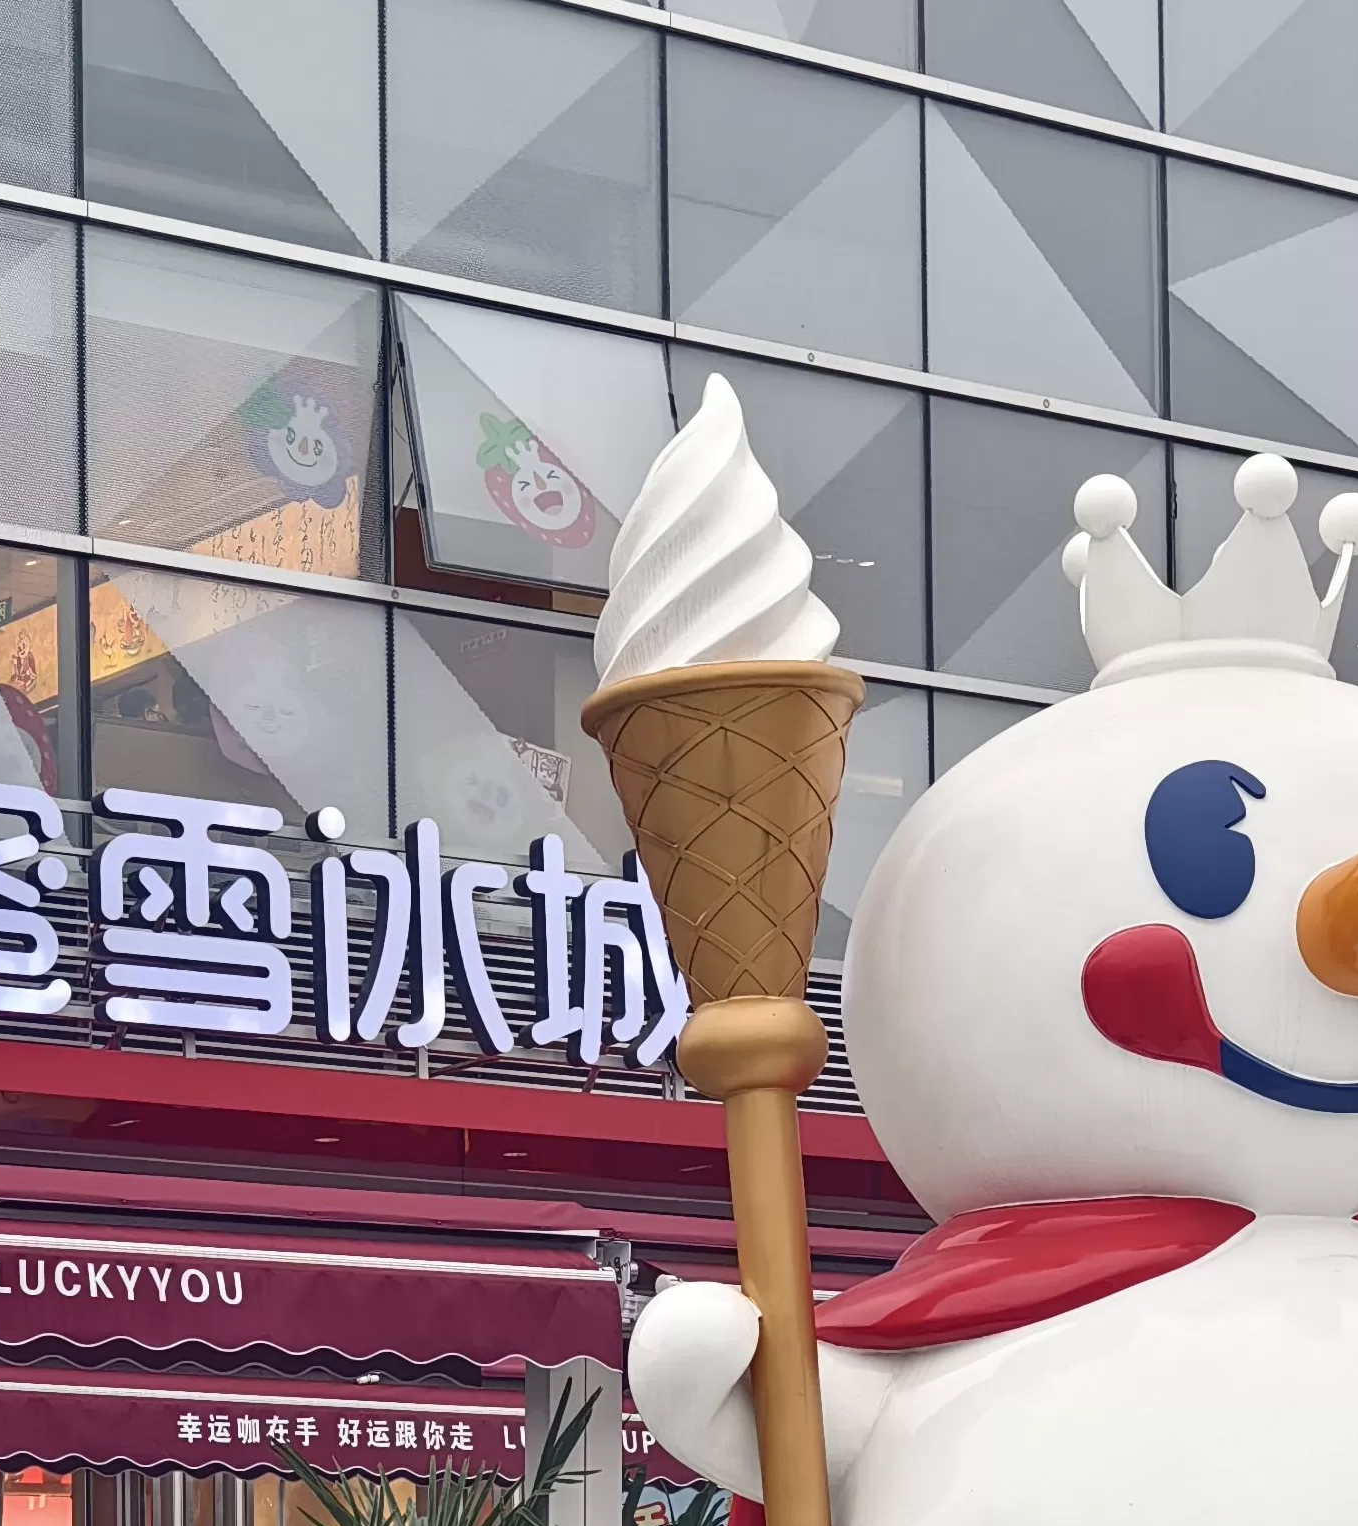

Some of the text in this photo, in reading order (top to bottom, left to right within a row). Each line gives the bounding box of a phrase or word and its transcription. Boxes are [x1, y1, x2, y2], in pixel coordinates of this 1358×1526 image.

[177, 1412, 319, 1447] 幸运咖在手
[337, 1417, 474, 1451] 好运跟你走
[621, 1429, 656, 1454] UP
